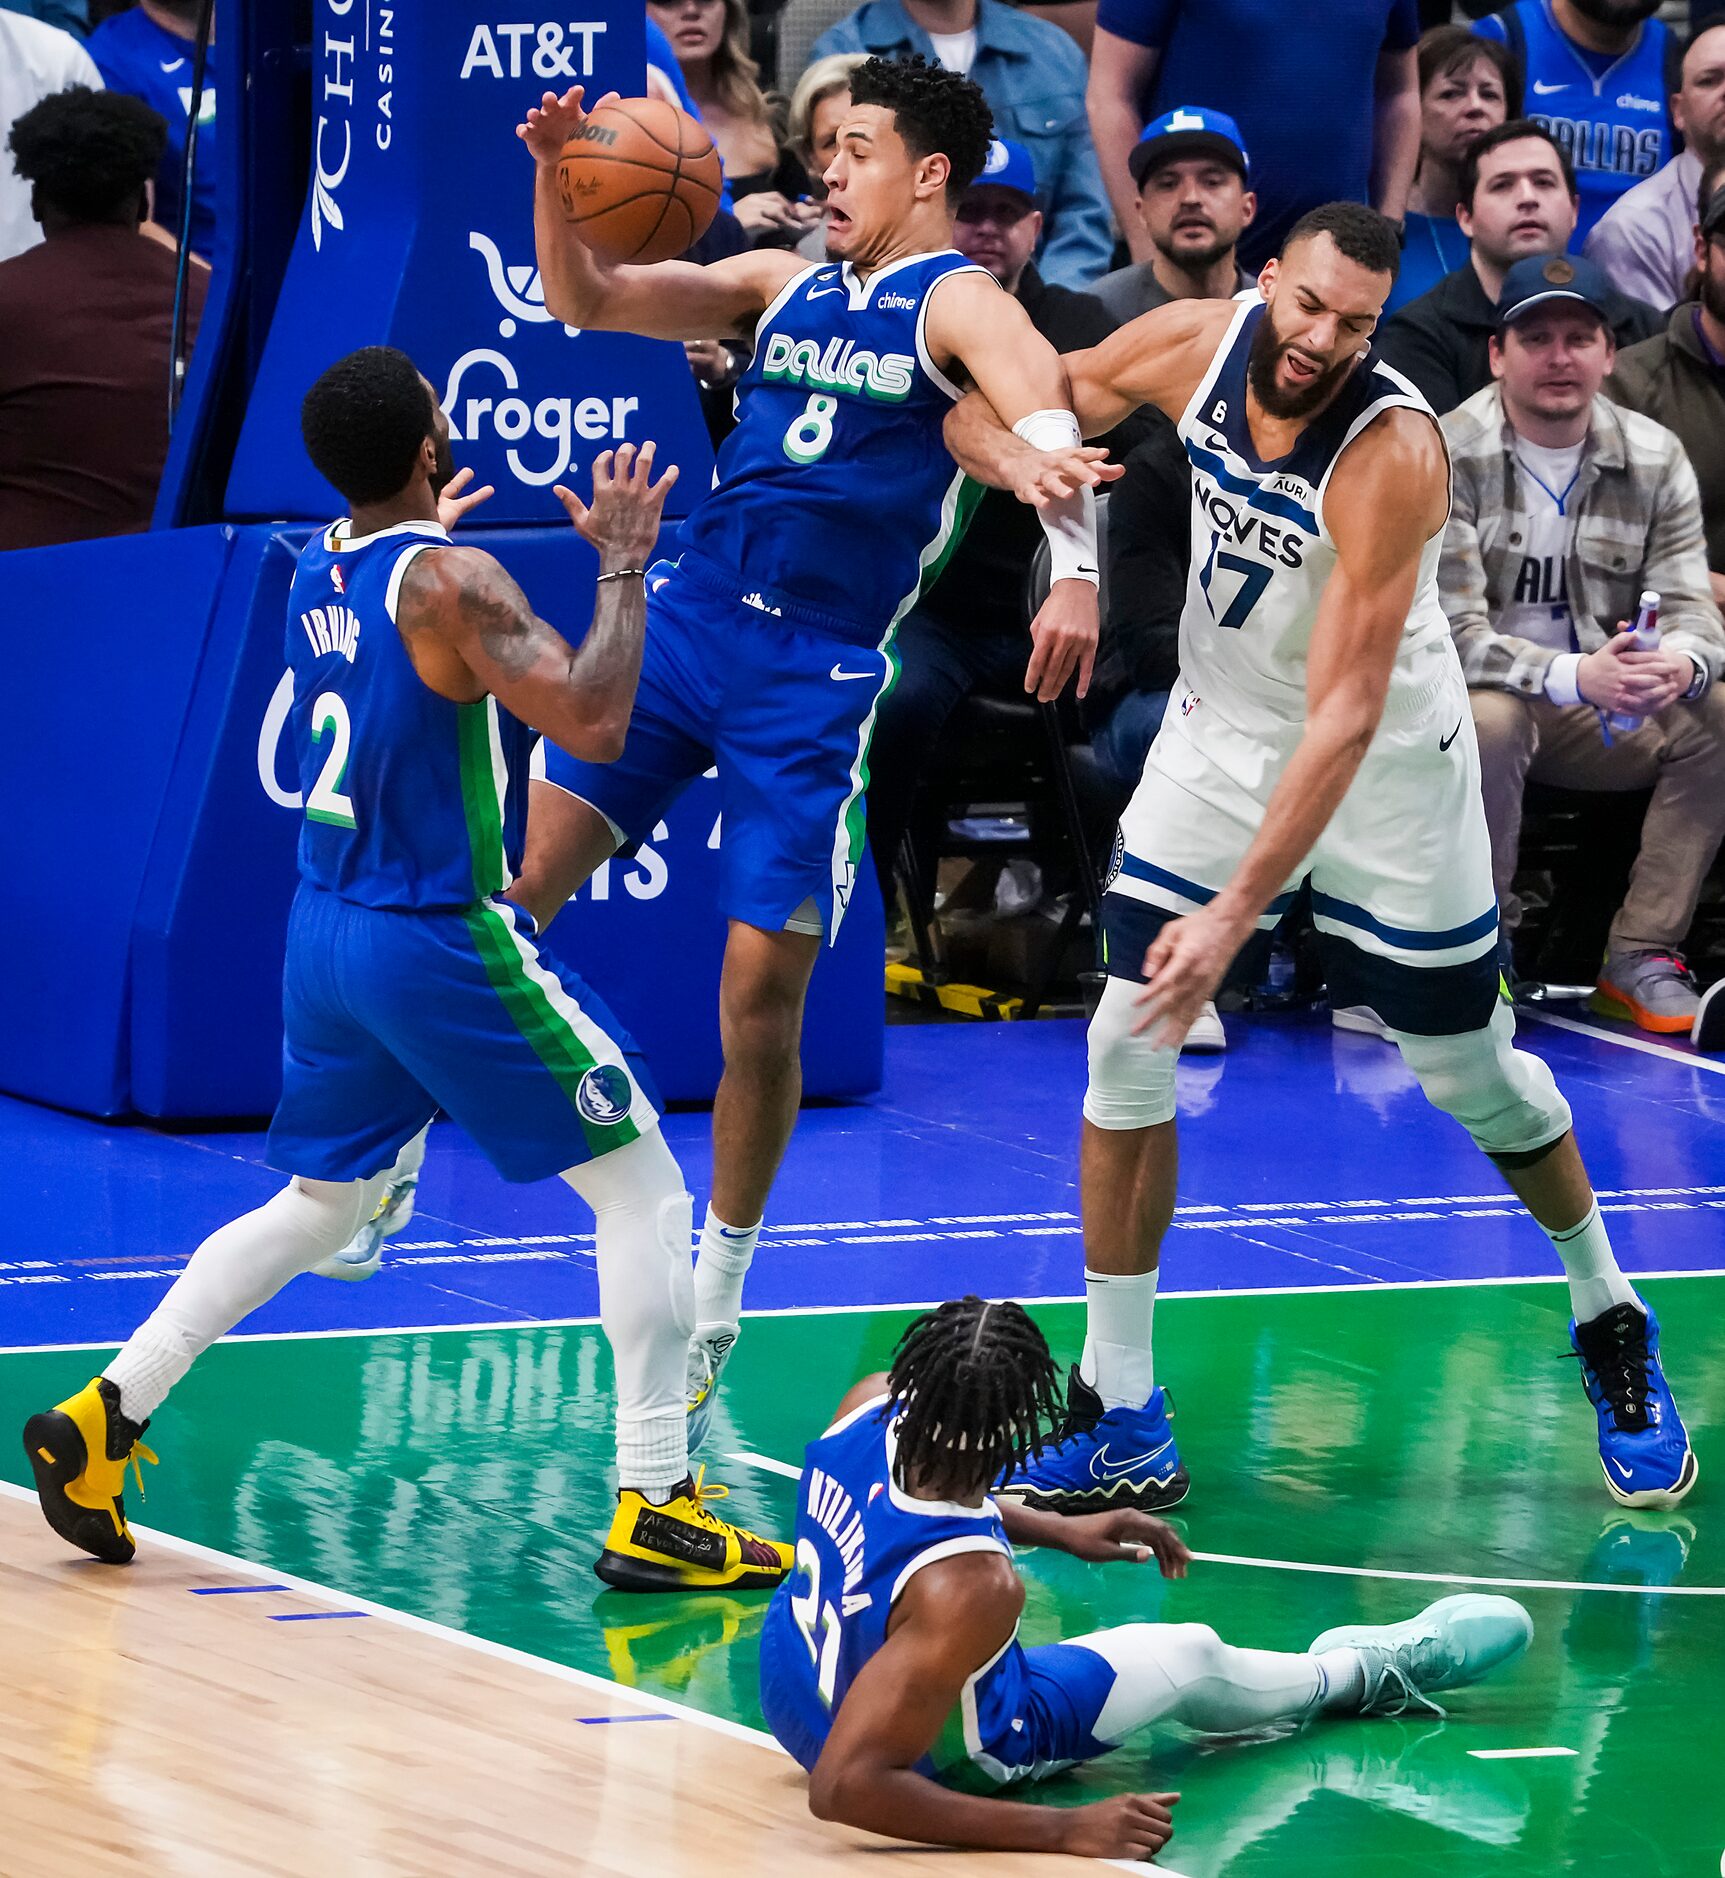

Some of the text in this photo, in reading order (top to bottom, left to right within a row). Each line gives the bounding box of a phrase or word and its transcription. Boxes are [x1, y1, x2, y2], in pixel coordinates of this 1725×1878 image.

[376, 0, 394, 151] CASIN
[460, 21, 607, 79] AT&T
[877, 291, 917, 311] chime
[762, 332, 916, 404] Dallas
[439, 348, 639, 487] Kroger
[782, 392, 839, 465] 8
[1211, 399, 1228, 424] 6
[1198, 529, 1275, 630] 7
[305, 690, 359, 830] 2
